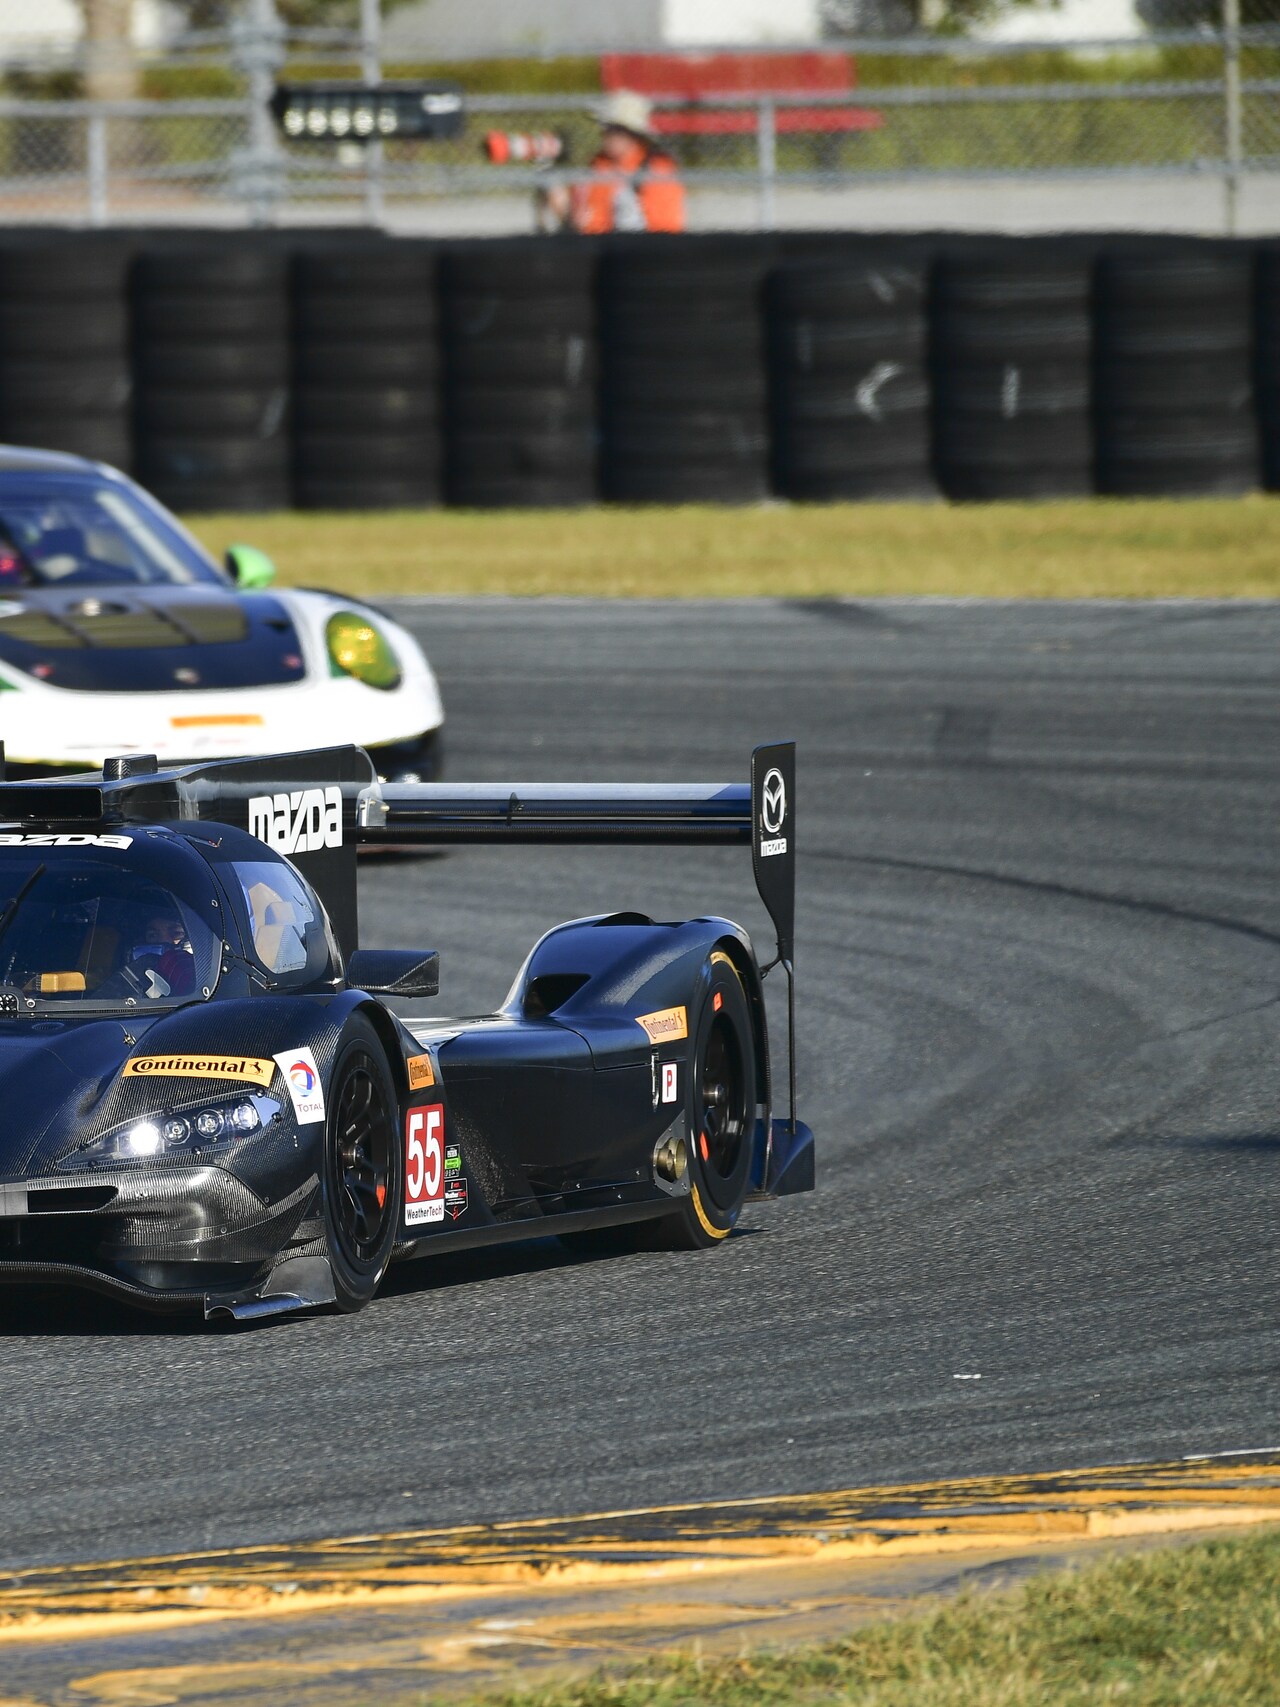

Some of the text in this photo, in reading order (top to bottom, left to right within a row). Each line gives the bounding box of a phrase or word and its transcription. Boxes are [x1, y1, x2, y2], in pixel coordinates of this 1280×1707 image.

[248, 786, 344, 855] mazda
[131, 1058, 246, 1073] Continental
[407, 1110, 441, 1199] 55
[407, 1204, 442, 1220] WeatherTech
